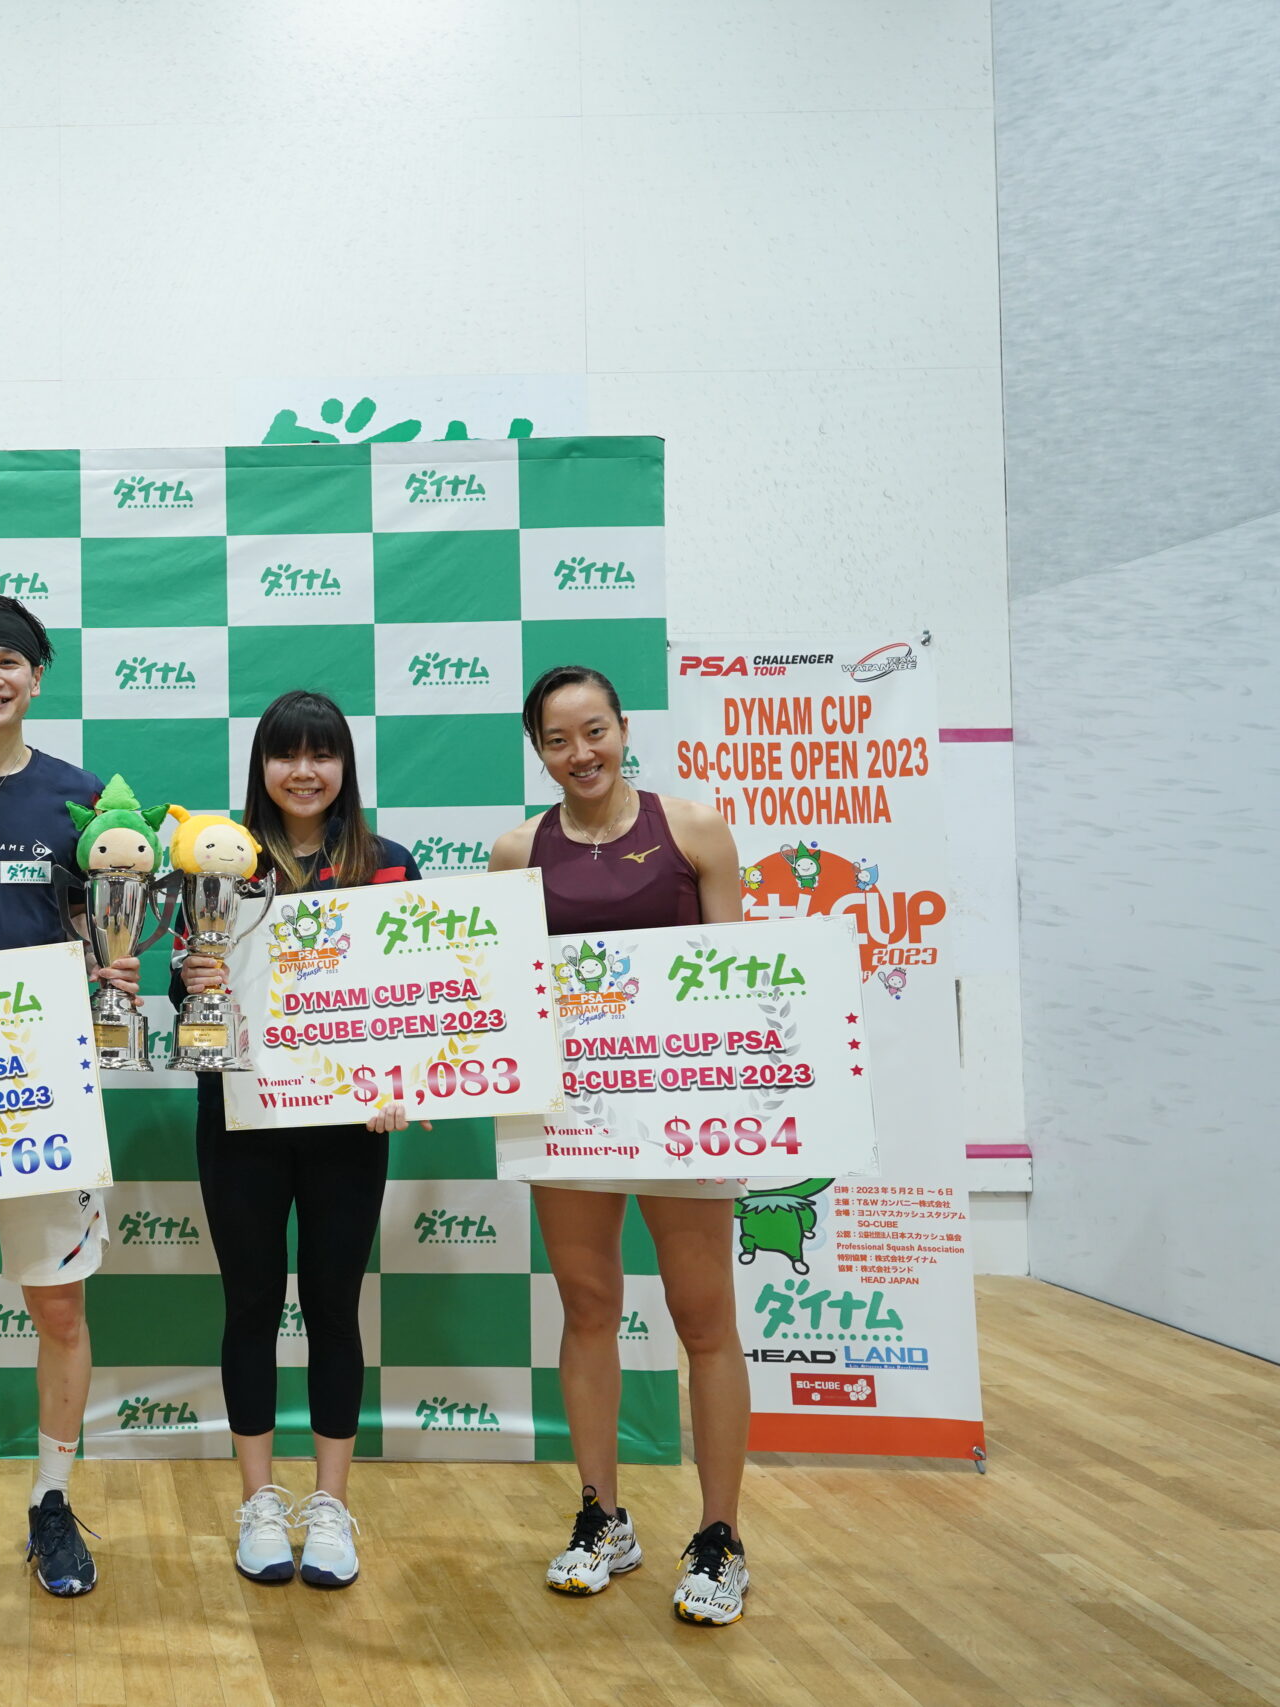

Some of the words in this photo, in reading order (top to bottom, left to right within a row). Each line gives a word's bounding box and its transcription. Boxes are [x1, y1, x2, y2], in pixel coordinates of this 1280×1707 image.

[113, 476, 194, 508] ダイナム
[405, 470, 486, 503] ダイナム
[260, 564, 341, 596] ダイナム
[554, 556, 635, 590] ダイナム
[115, 656, 196, 690] ダイナム
[408, 652, 490, 686] ダイナム
[679, 655, 749, 677] PSA
[753, 654, 834, 665] CHALLENGER
[753, 666, 787, 676] TOUR
[842, 663, 917, 673] WATANABE
[886, 656, 917, 664] TEAM
[724, 696, 812, 736] DYNAM
[821, 695, 872, 735] CUP
[677, 740, 783, 783] SQ-CUBE
[790, 740, 859, 781] OPEN
[866, 737, 929, 779] 2023
[715, 787, 736, 825] in
[742, 785, 892, 825] YOKOHAMA
[7, 864, 47, 881] ダイナム
[375, 904, 499, 954] ダイナム
[279, 961, 315, 974] DYNAM
[317, 959, 339, 969] CUP
[298, 950, 319, 960] PSA
[872, 947, 938, 966] 2023
[667, 949, 806, 1002] ダイナム
[284, 988, 369, 1014] DYNAM
[374, 983, 421, 1006] CUP
[430, 979, 478, 1000] PSA
[559, 1005, 599, 1018] DYNAM
[601, 1003, 627, 1014] CUP
[581, 994, 604, 1003] PSA
[265, 1020, 364, 1046] SQ-CUBE
[370, 1014, 437, 1037] OPEN
[443, 1009, 504, 1031] 2023
[565, 1034, 657, 1057] DYNAM
[665, 1032, 719, 1052] CUP
[727, 1029, 783, 1050] PSA
[351, 1057, 521, 1106] $1,083
[562, 1068, 654, 1093] Q-CUBE
[661, 1066, 734, 1088] OPEN
[742, 1063, 813, 1085] 2023
[259, 1094, 334, 1109] Winner
[545, 1143, 640, 1159] Runner-up
[664, 1115, 802, 1160] $684
[118, 1211, 199, 1245] ダイナム
[414, 1209, 497, 1243] ダイナム
[836, 1243, 884, 1251] Professional
[886, 1244, 915, 1252] Squash
[917, 1245, 965, 1254] Association
[754, 1279, 904, 1341] ダイナム
[844, 1345, 929, 1363] LAND
[796, 1381, 840, 1390] SQ-CUBE
[117, 1396, 199, 1430] ダイナム
[415, 1397, 500, 1432] ダイナム
